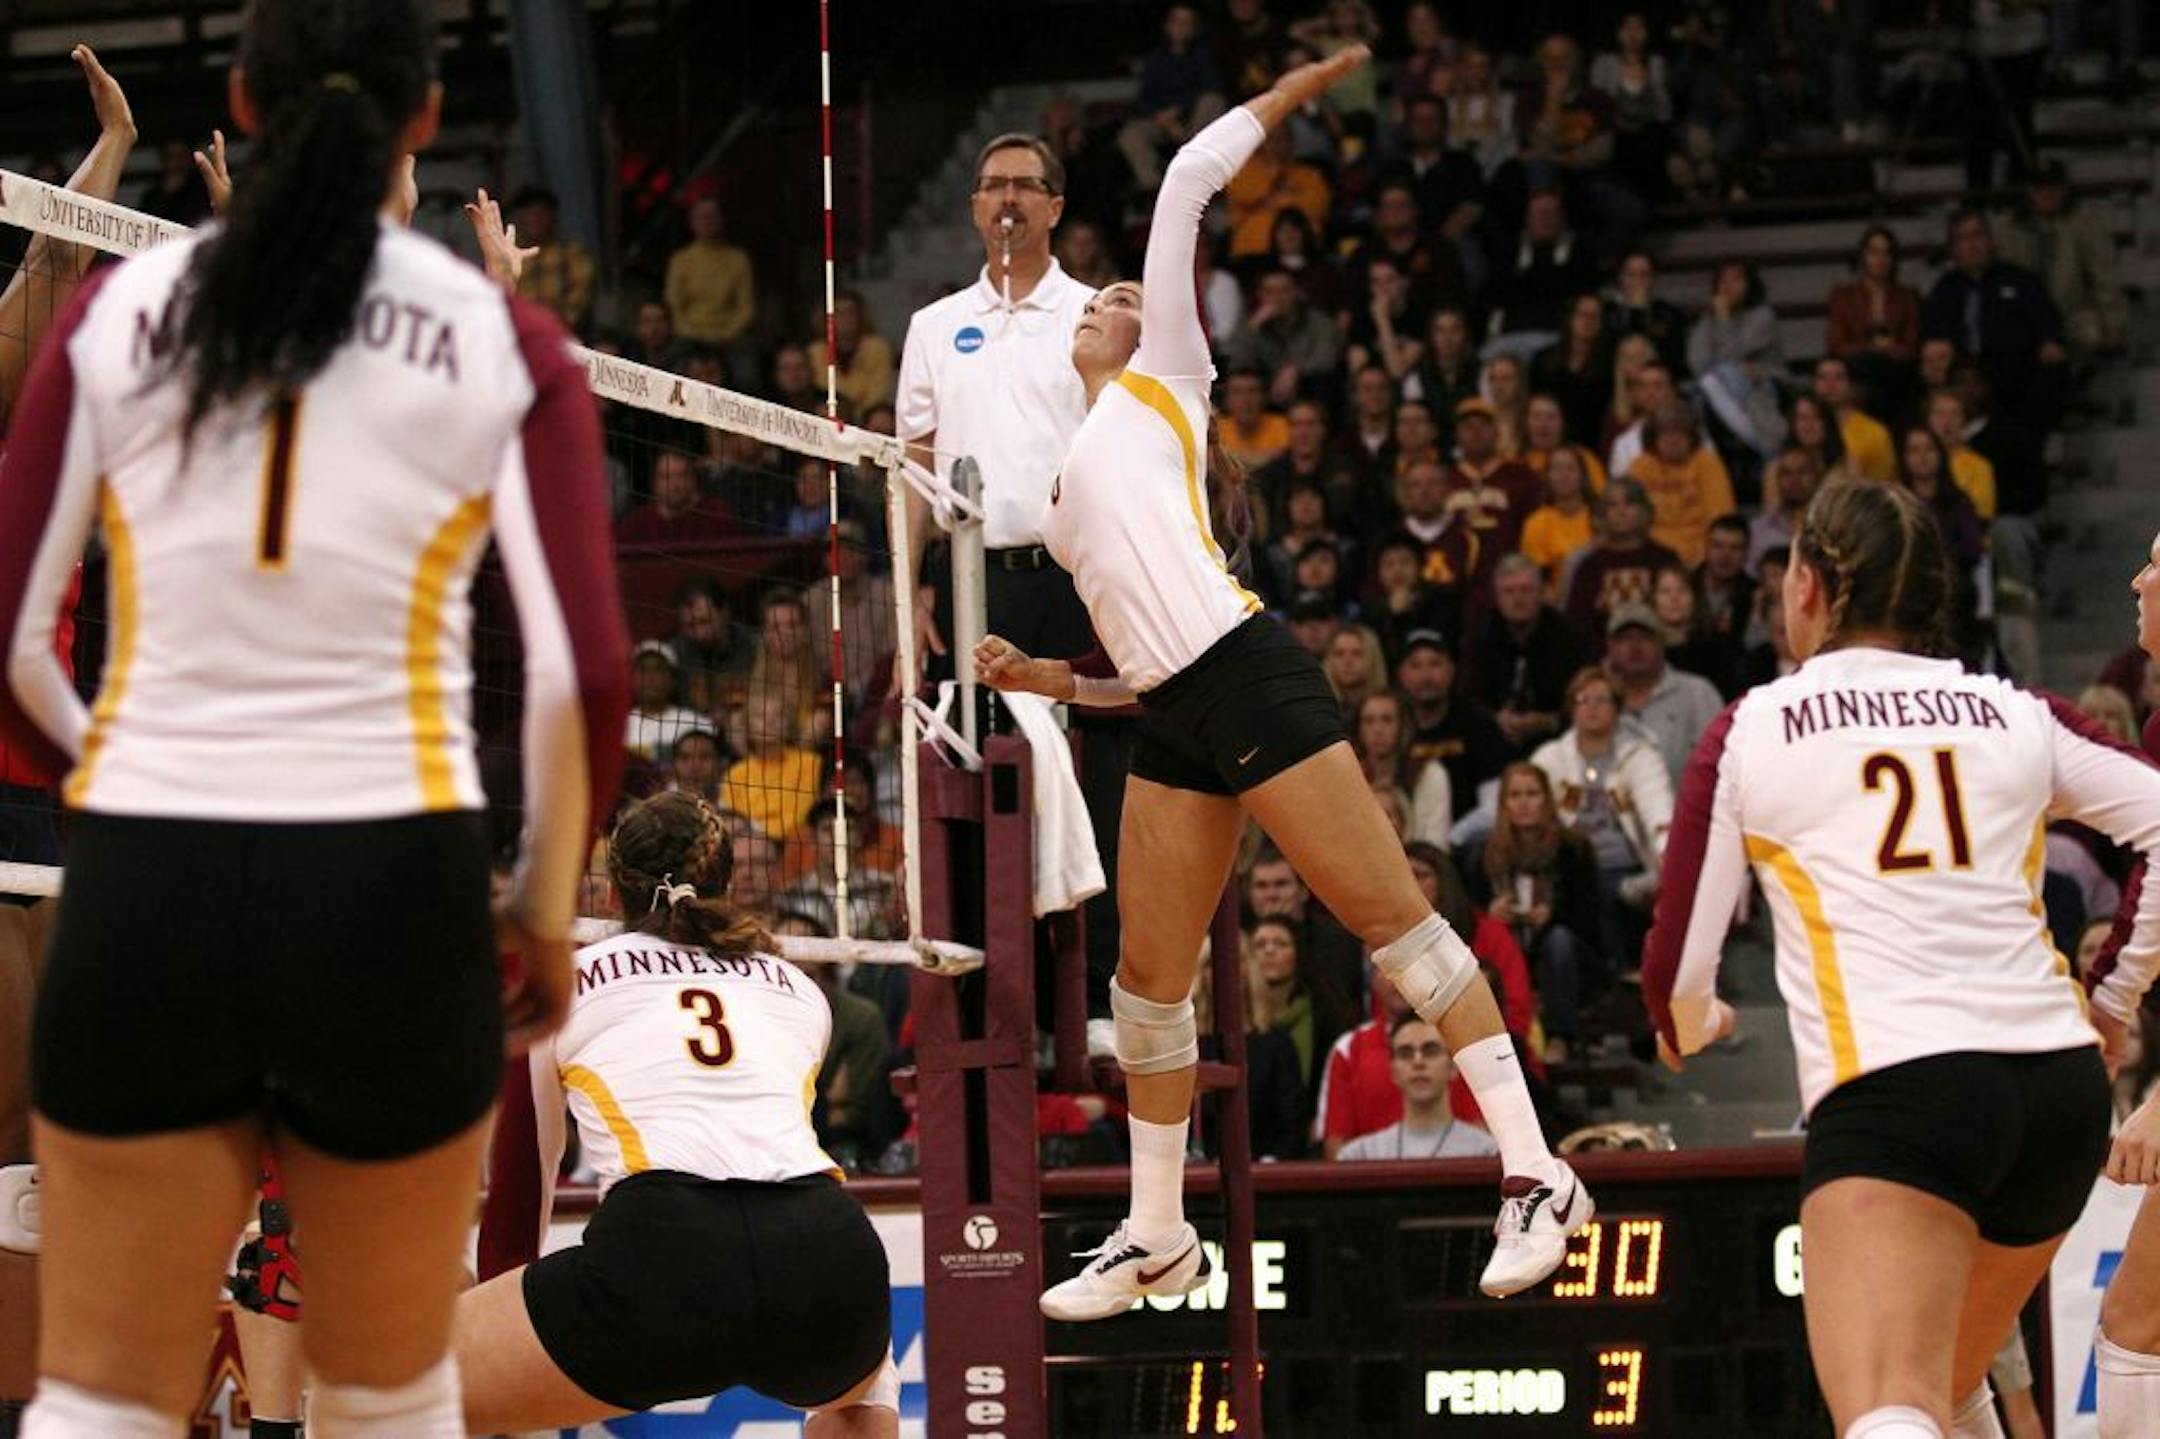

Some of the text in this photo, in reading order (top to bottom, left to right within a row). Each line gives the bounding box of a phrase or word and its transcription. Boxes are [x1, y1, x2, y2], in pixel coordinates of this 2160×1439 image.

[1781, 689, 2008, 744] MINNESOTA
[1861, 746, 1973, 874] 21
[576, 949, 796, 996] MINNESOTA
[678, 986, 737, 1068] 3
[1425, 1350, 1643, 1426] PERIOD 3
